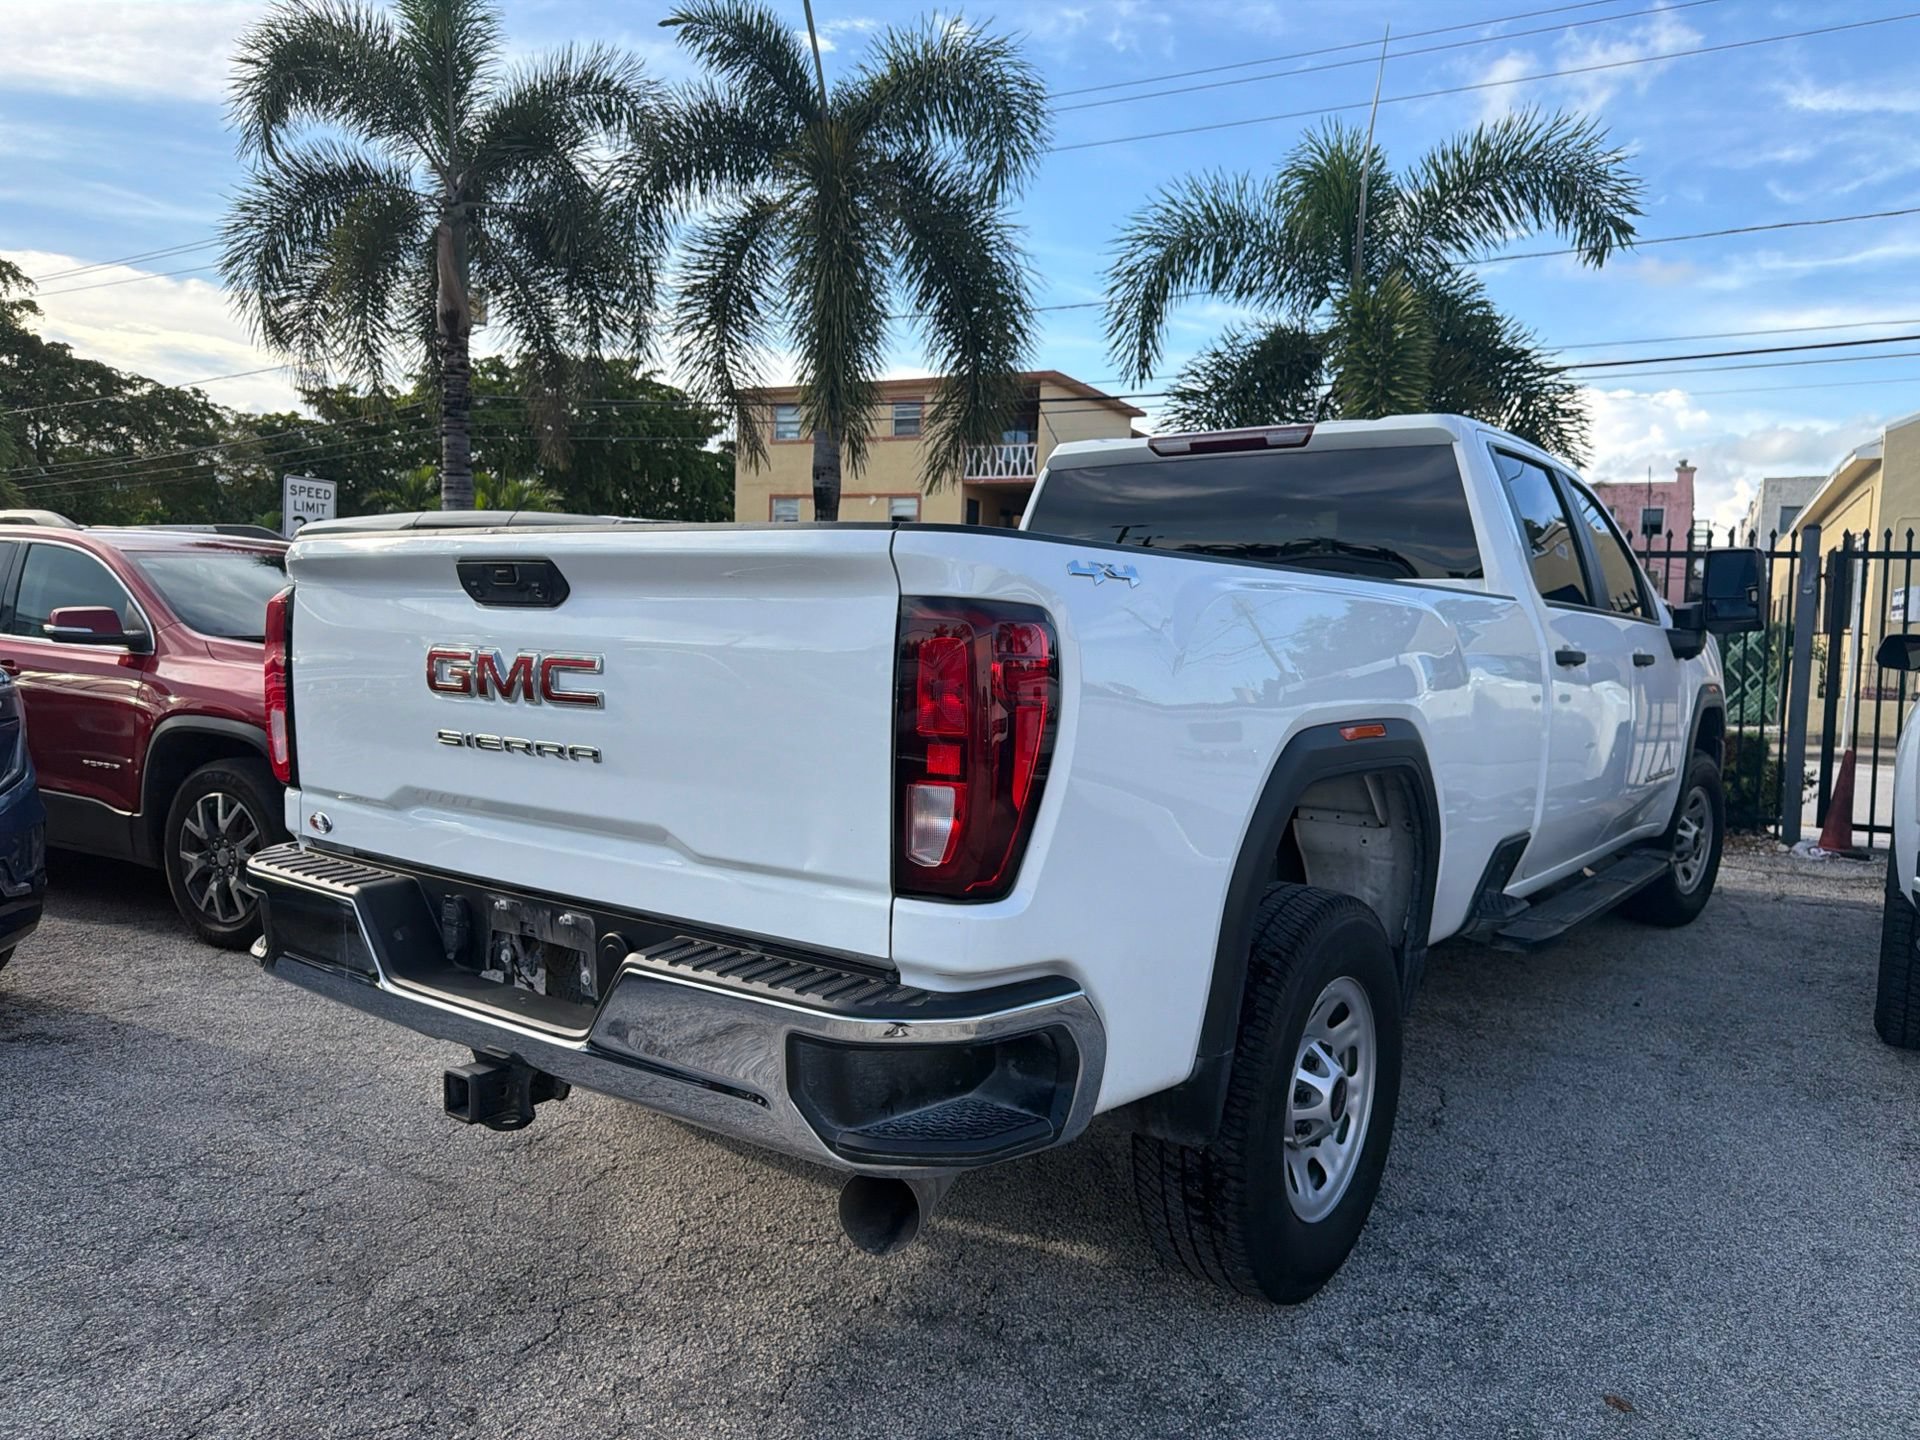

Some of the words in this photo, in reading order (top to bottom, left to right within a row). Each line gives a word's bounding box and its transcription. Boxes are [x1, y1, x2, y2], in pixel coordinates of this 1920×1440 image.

[290, 484, 332, 500] SPEED
[293, 499, 328, 514] LIMIT
[427, 644, 605, 710] GMC
[437, 729, 602, 763] SIERRA
